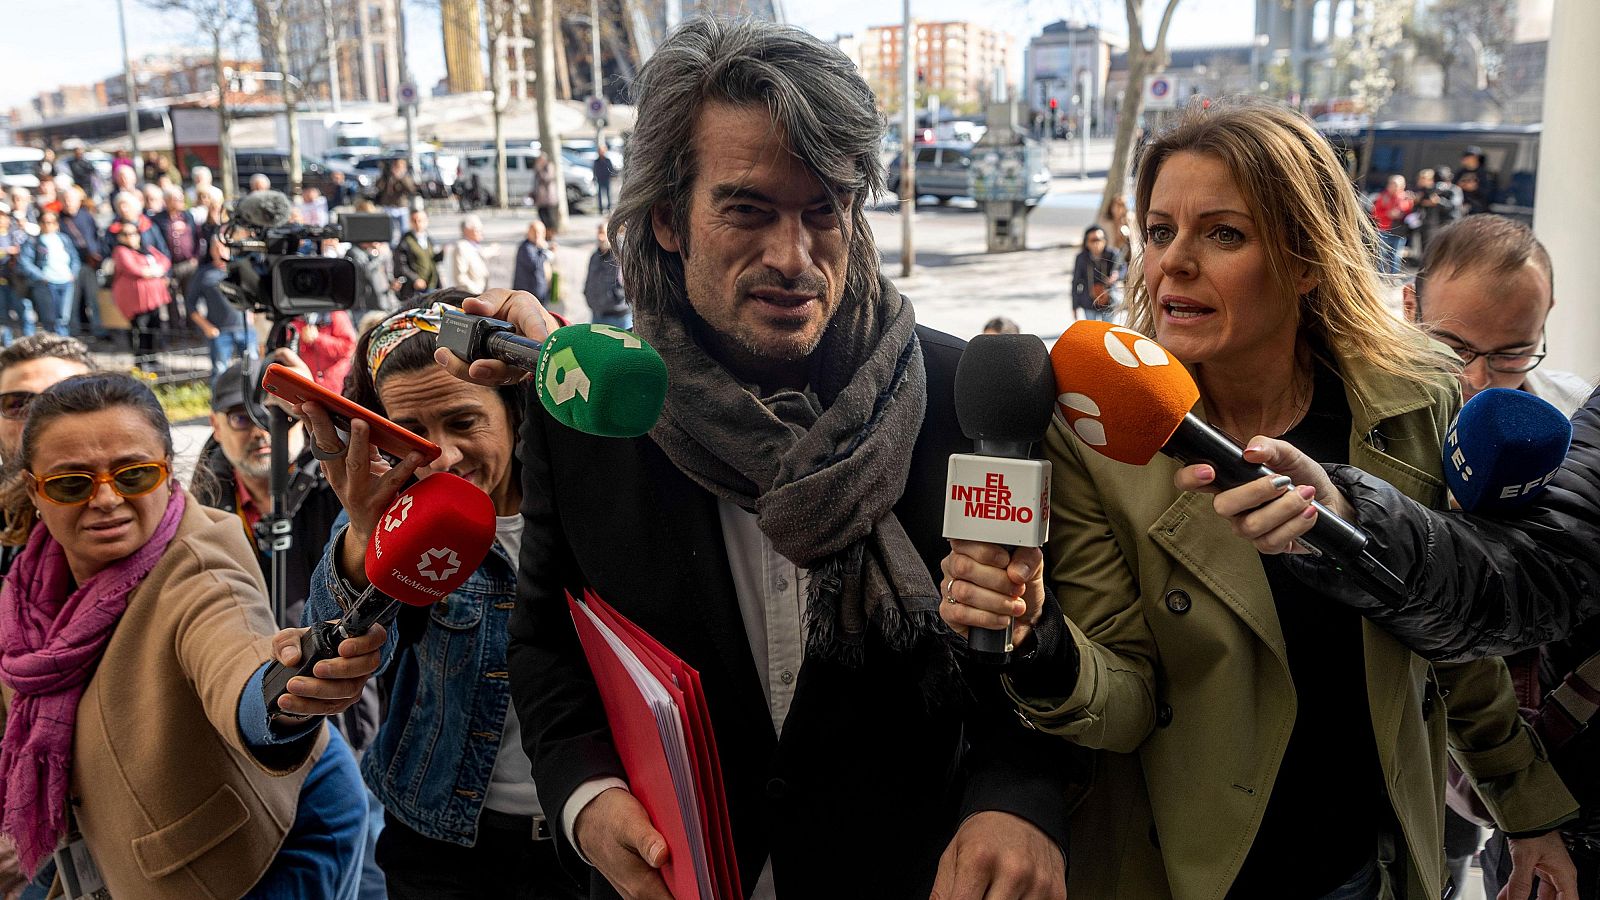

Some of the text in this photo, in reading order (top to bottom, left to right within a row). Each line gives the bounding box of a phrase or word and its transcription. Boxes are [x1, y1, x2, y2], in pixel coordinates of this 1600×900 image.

[986, 472, 1009, 490] EL
[951, 484, 1012, 506] INTER
[964, 501, 1033, 524] MEDIO
[391, 568, 446, 598] TeleMadrid
